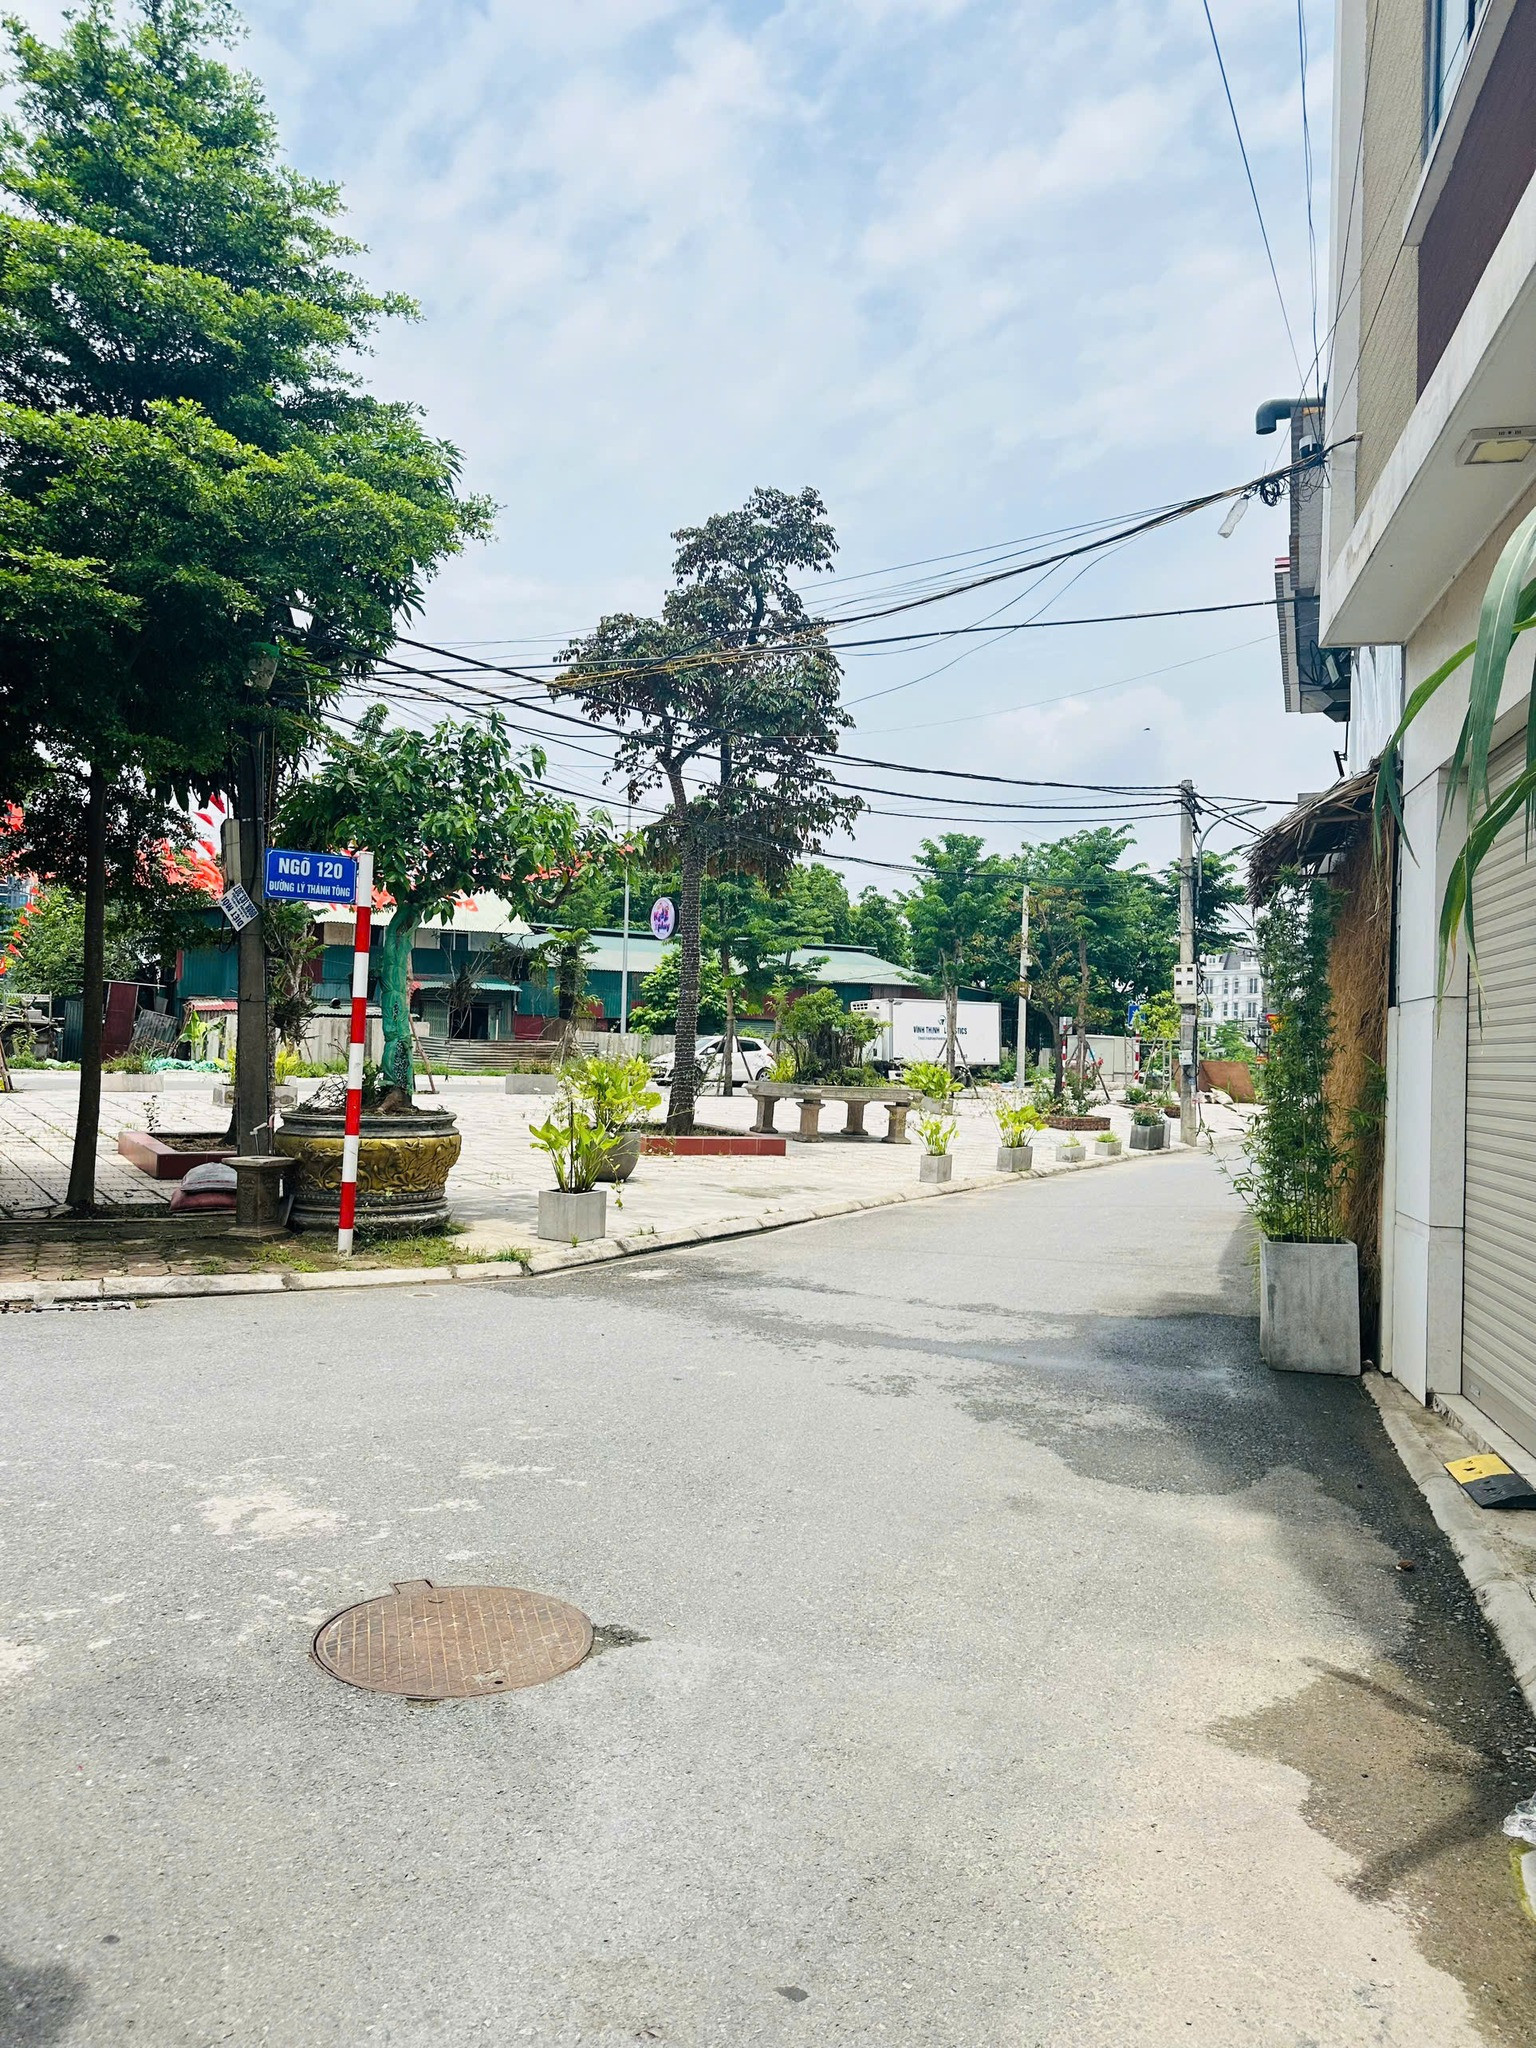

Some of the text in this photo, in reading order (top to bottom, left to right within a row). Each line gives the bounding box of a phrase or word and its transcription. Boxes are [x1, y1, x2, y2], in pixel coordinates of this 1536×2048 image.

[278, 857, 343, 879] NGÕ 120
[269, 879, 351, 897] ĐƯỜNG LÝ THÁNH TÔNG
